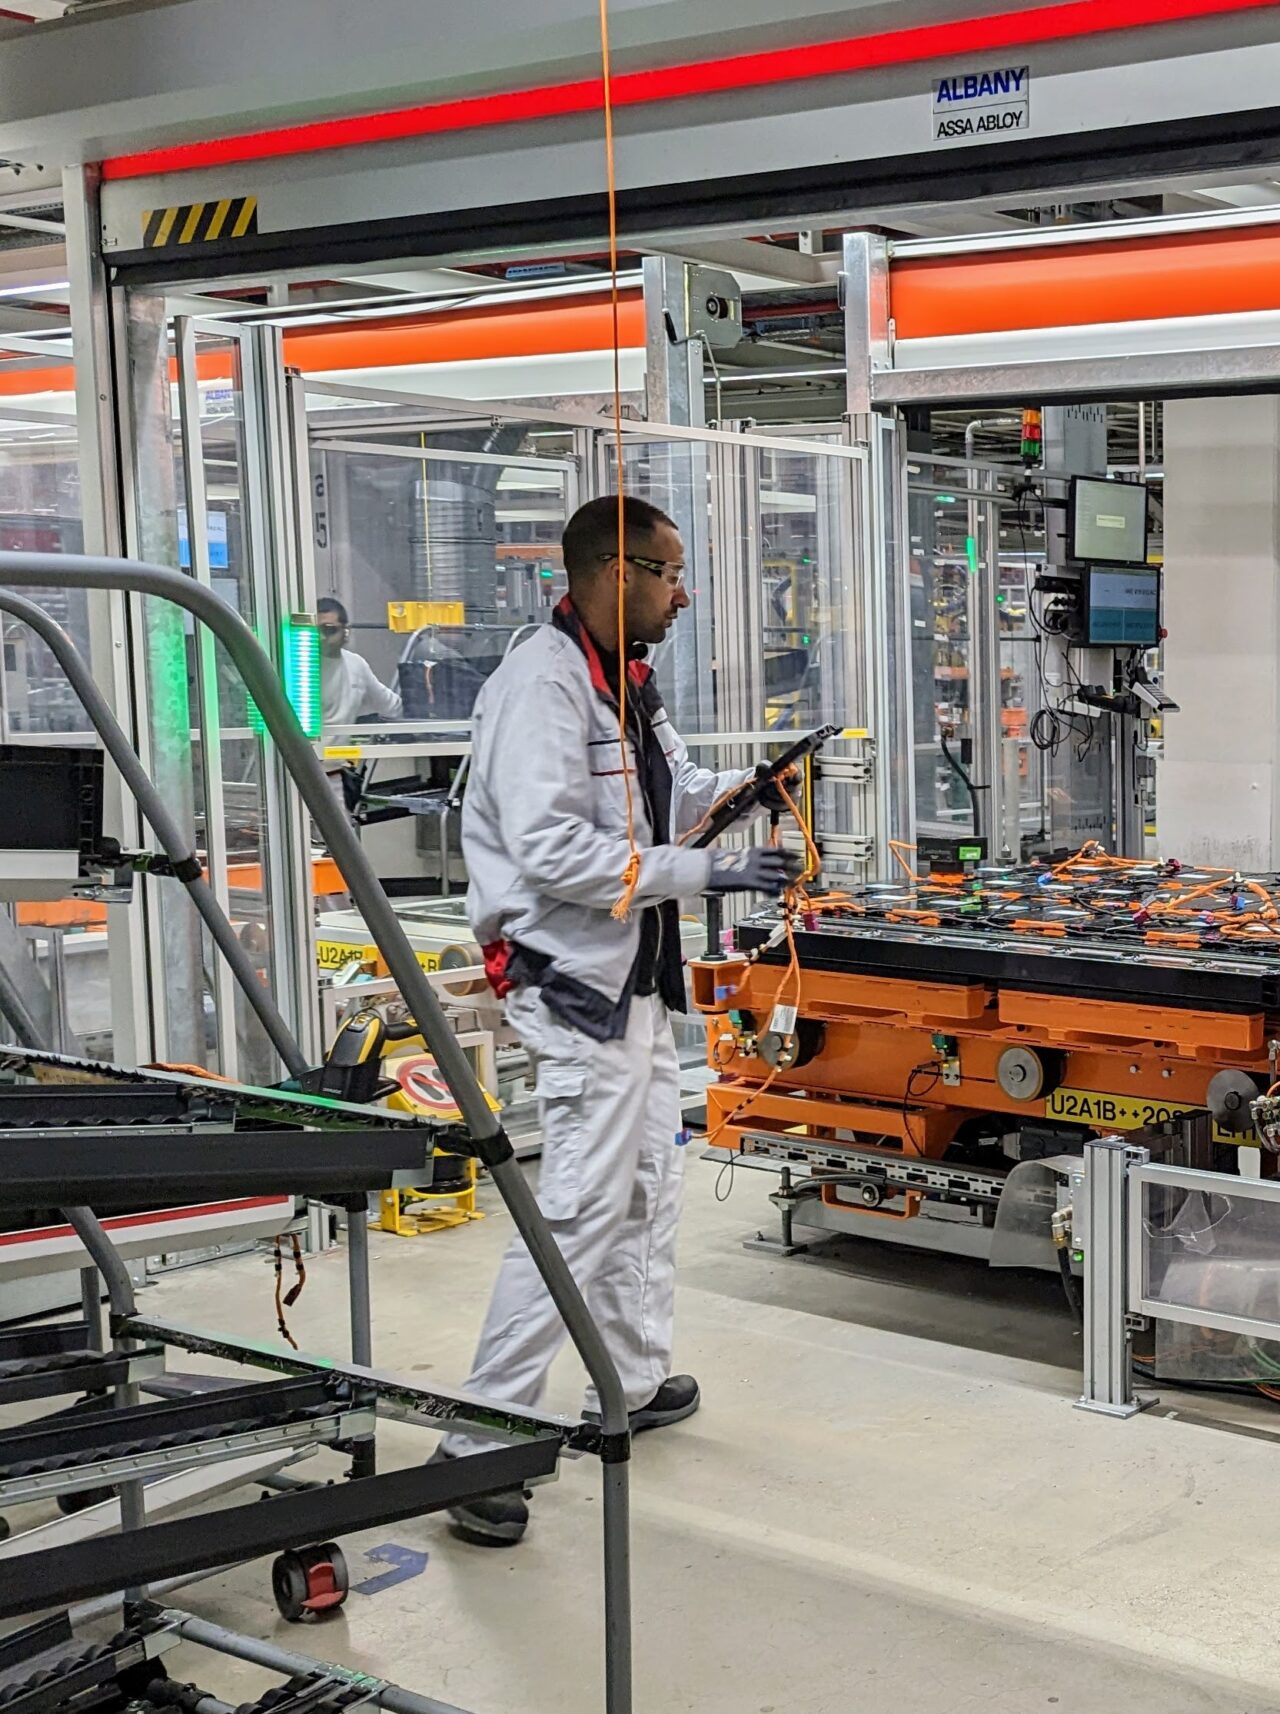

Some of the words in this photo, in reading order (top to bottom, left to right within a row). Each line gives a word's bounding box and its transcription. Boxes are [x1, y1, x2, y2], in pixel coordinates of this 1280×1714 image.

[937, 67, 1026, 103] ALBANY
[937, 118, 974, 138] ASSA
[976, 110, 1023, 132] ABLOY
